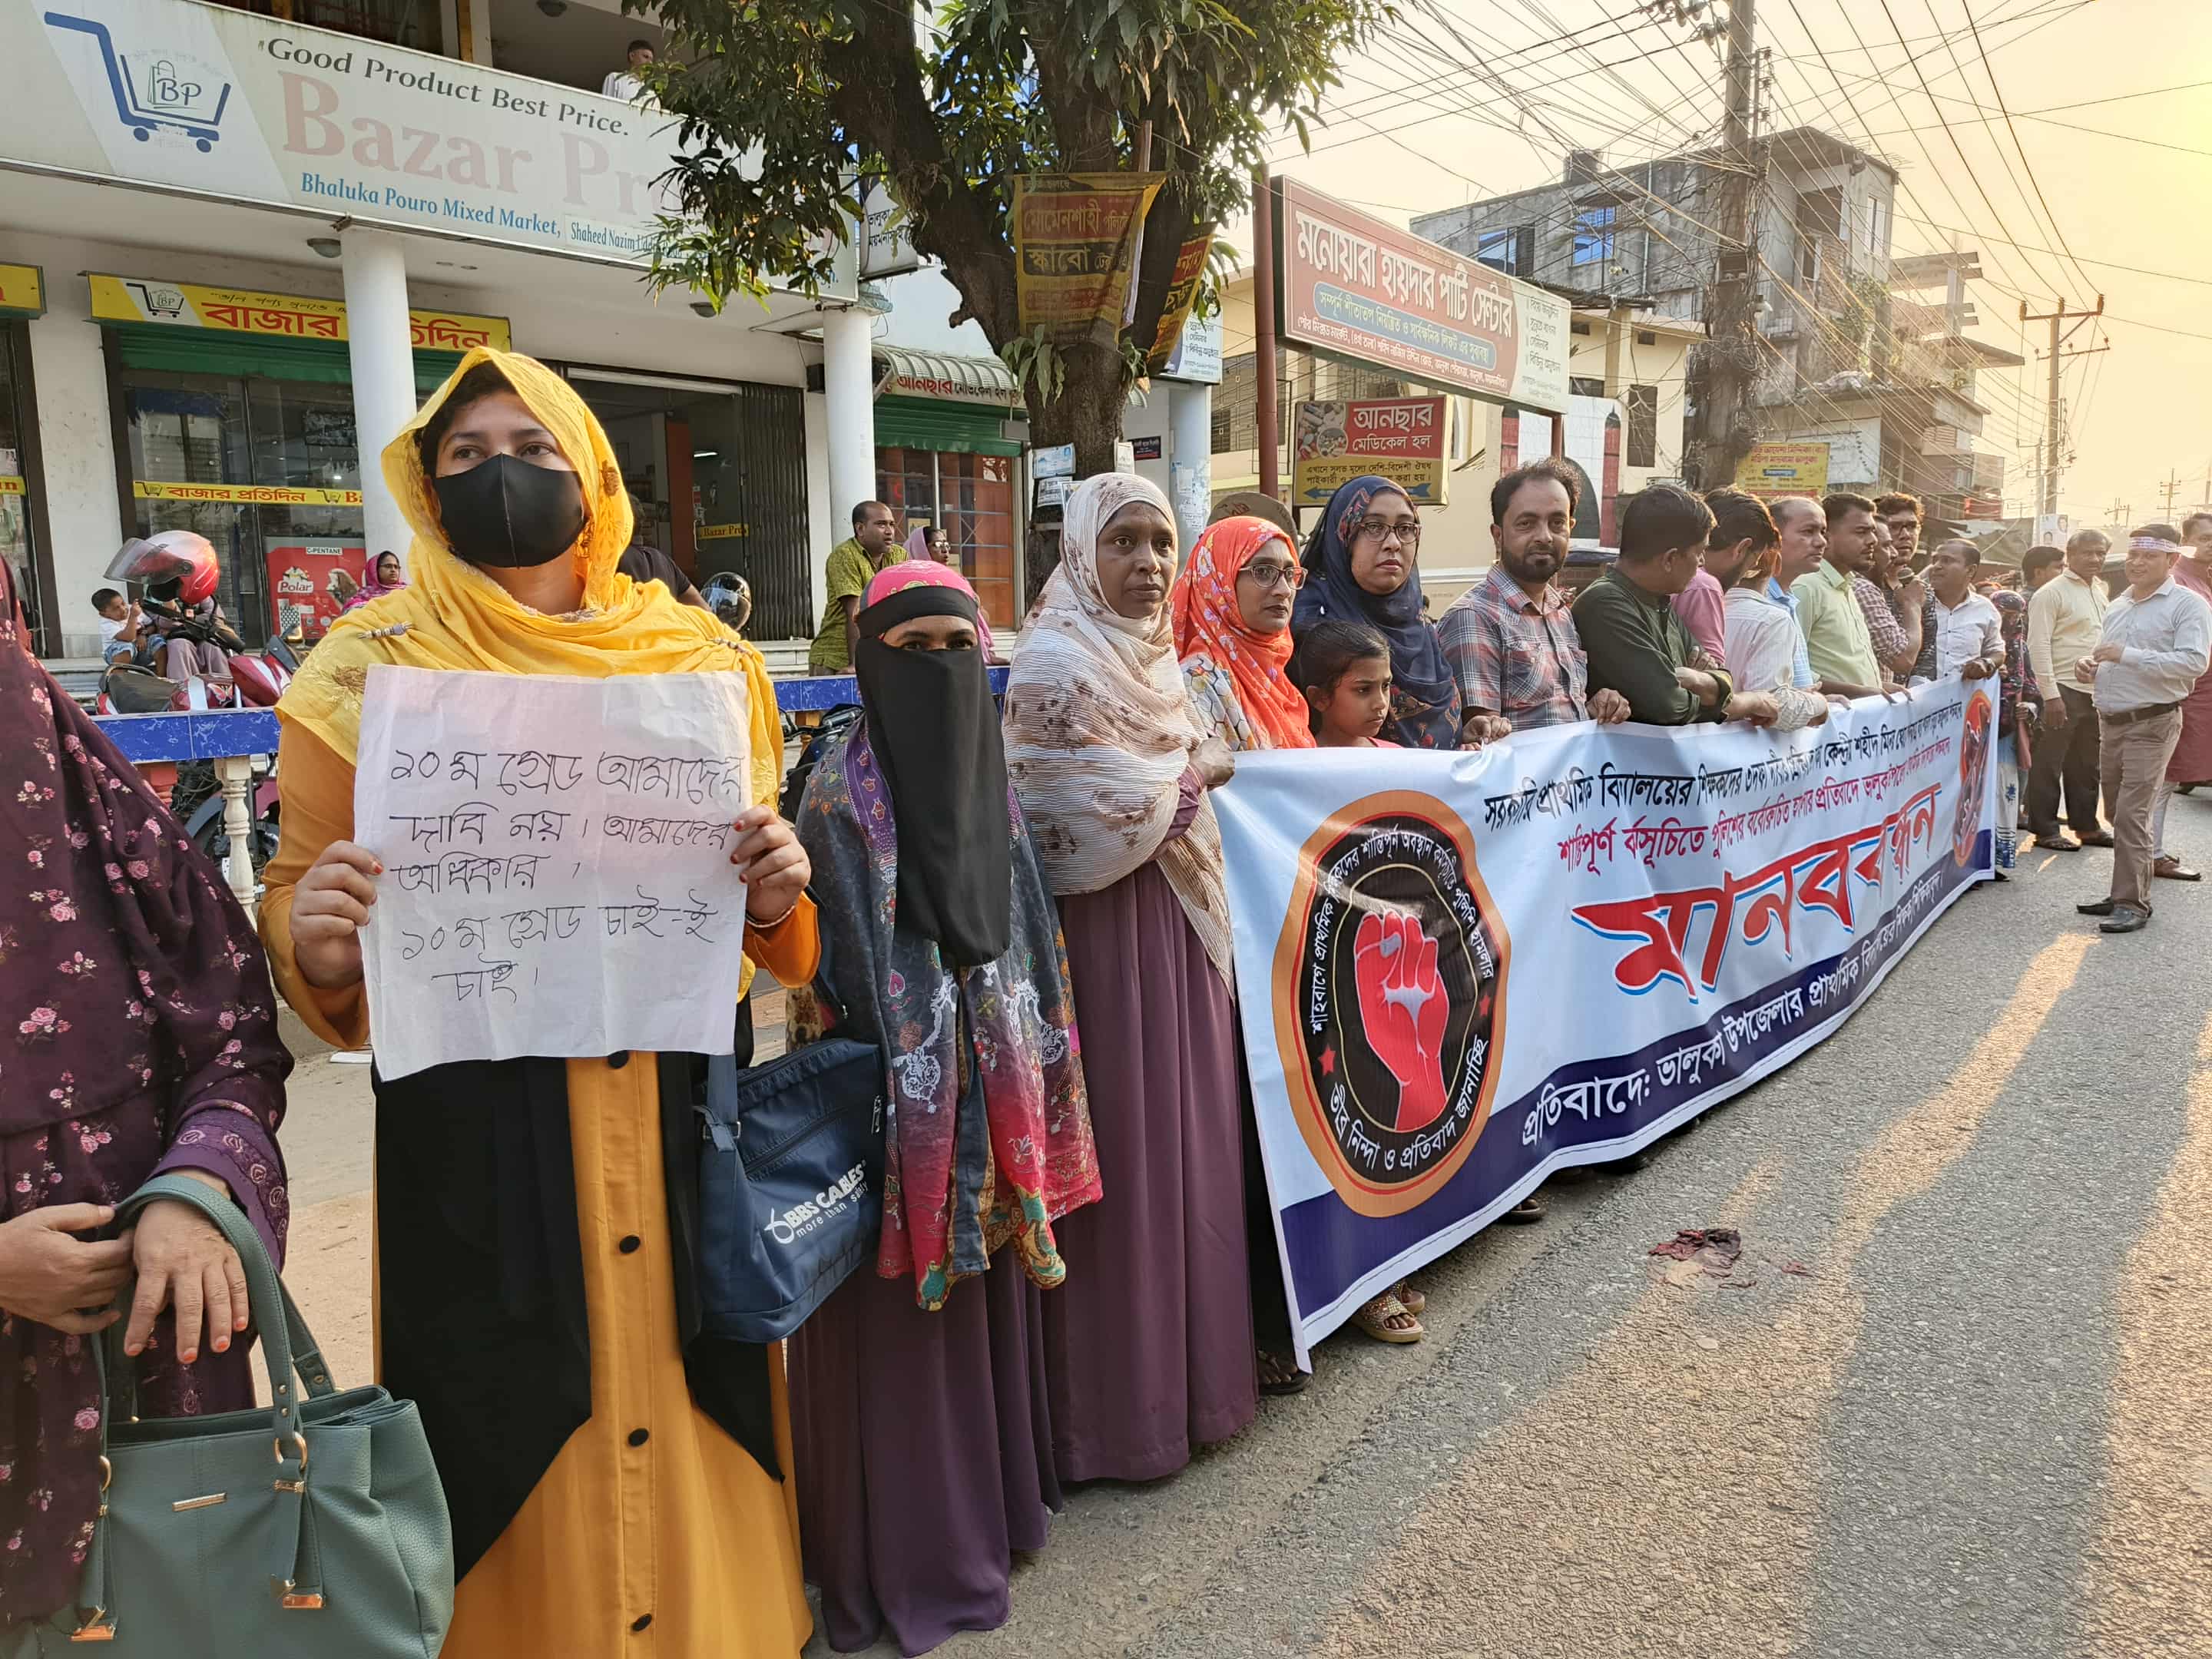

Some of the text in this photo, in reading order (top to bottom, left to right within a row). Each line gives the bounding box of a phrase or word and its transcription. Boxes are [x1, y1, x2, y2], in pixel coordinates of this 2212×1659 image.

[157, 78, 201, 105] BP
[365, 58, 482, 102] Product
[492, 88, 549, 118] Best
[558, 103, 629, 136] Price.
[278, 71, 532, 194] Bazar
[301, 172, 379, 204] Bhaluka
[385, 187, 438, 214] Pouro
[442, 199, 494, 225] Mixed
[498, 207, 561, 238] Market,
[571, 221, 607, 246] Shaheed
[608, 228, 635, 250] Nazim
[1295, 210, 1376, 289] মনোয়ারা
[1379, 247, 1435, 311] হায়দার
[201, 302, 340, 337] বাজার
[1353, 403, 1433, 432] আনছার
[1353, 435, 1432, 452] মেডিকেল হল
[167, 486, 305, 502] বাজার প্রতিদিন
[280, 581, 312, 591] Polar
[1854, 726, 1878, 760] শহীদ
[497, 750, 584, 796] গ্রেড
[597, 750, 745, 805] আমাদের
[389, 801, 499, 854] দাবি
[603, 812, 733, 850] আমাদের
[501, 905, 586, 949] গ্রেড
[1314, 897, 1333, 960] প্রাথমিক
[1471, 927, 1494, 979] হামলার
[1310, 962, 1328, 1035] শাহবাগে
[1656, 1031, 1725, 1088] ভালুকা
[1722, 988, 1804, 1053] উপজেলার
[1809, 952, 1859, 1007] প্রাথমিক
[1347, 1119, 1380, 1170] নিন্দা
[1384, 1149, 1396, 1171] ও
[1400, 1116, 1456, 1170] প্রতিবাদ
[783, 1164, 864, 1228] BBS CABLES
[796, 1216, 823, 1237] more
[824, 1202, 847, 1218] than
